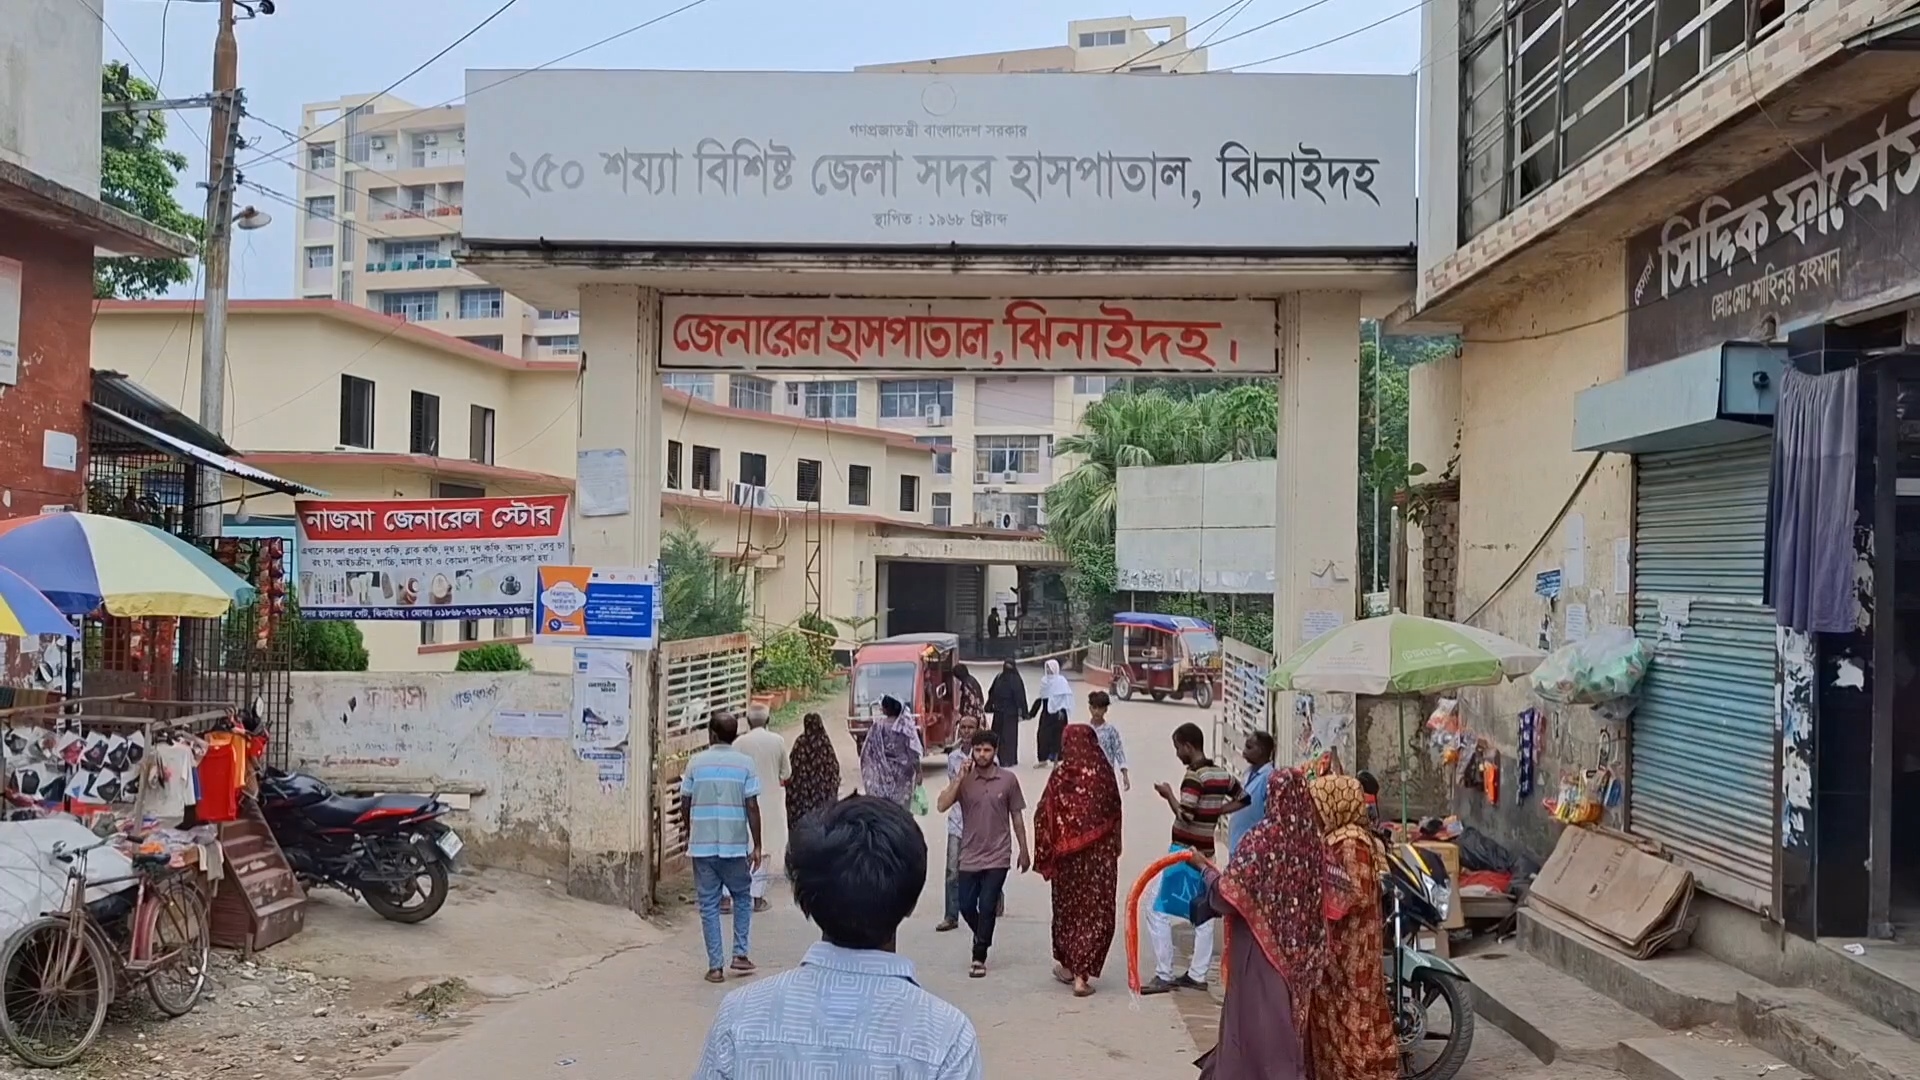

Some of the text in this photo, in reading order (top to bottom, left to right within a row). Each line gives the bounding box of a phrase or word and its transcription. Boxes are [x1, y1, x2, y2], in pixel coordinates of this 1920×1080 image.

[849, 119, 1028, 139] গণপ্রজাতন্ত্রী বাংলাদেশ সরকার
[505, 138, 1381, 208] ২৫০ শয্যা বিশিষ্ট জেলা সদর হাসপাতাল, ঝিনাইদহ
[929, 212, 965, 227] ১৯৬৮
[1658, 195, 1770, 300] সিদ্দিক
[1798, 247, 1841, 290] রহমান
[673, 313, 824, 358] জেনারেল
[304, 500, 554, 532] নাজমা জেনারেল স্টোর
[319, 608, 353, 619] হাসপাতাল
